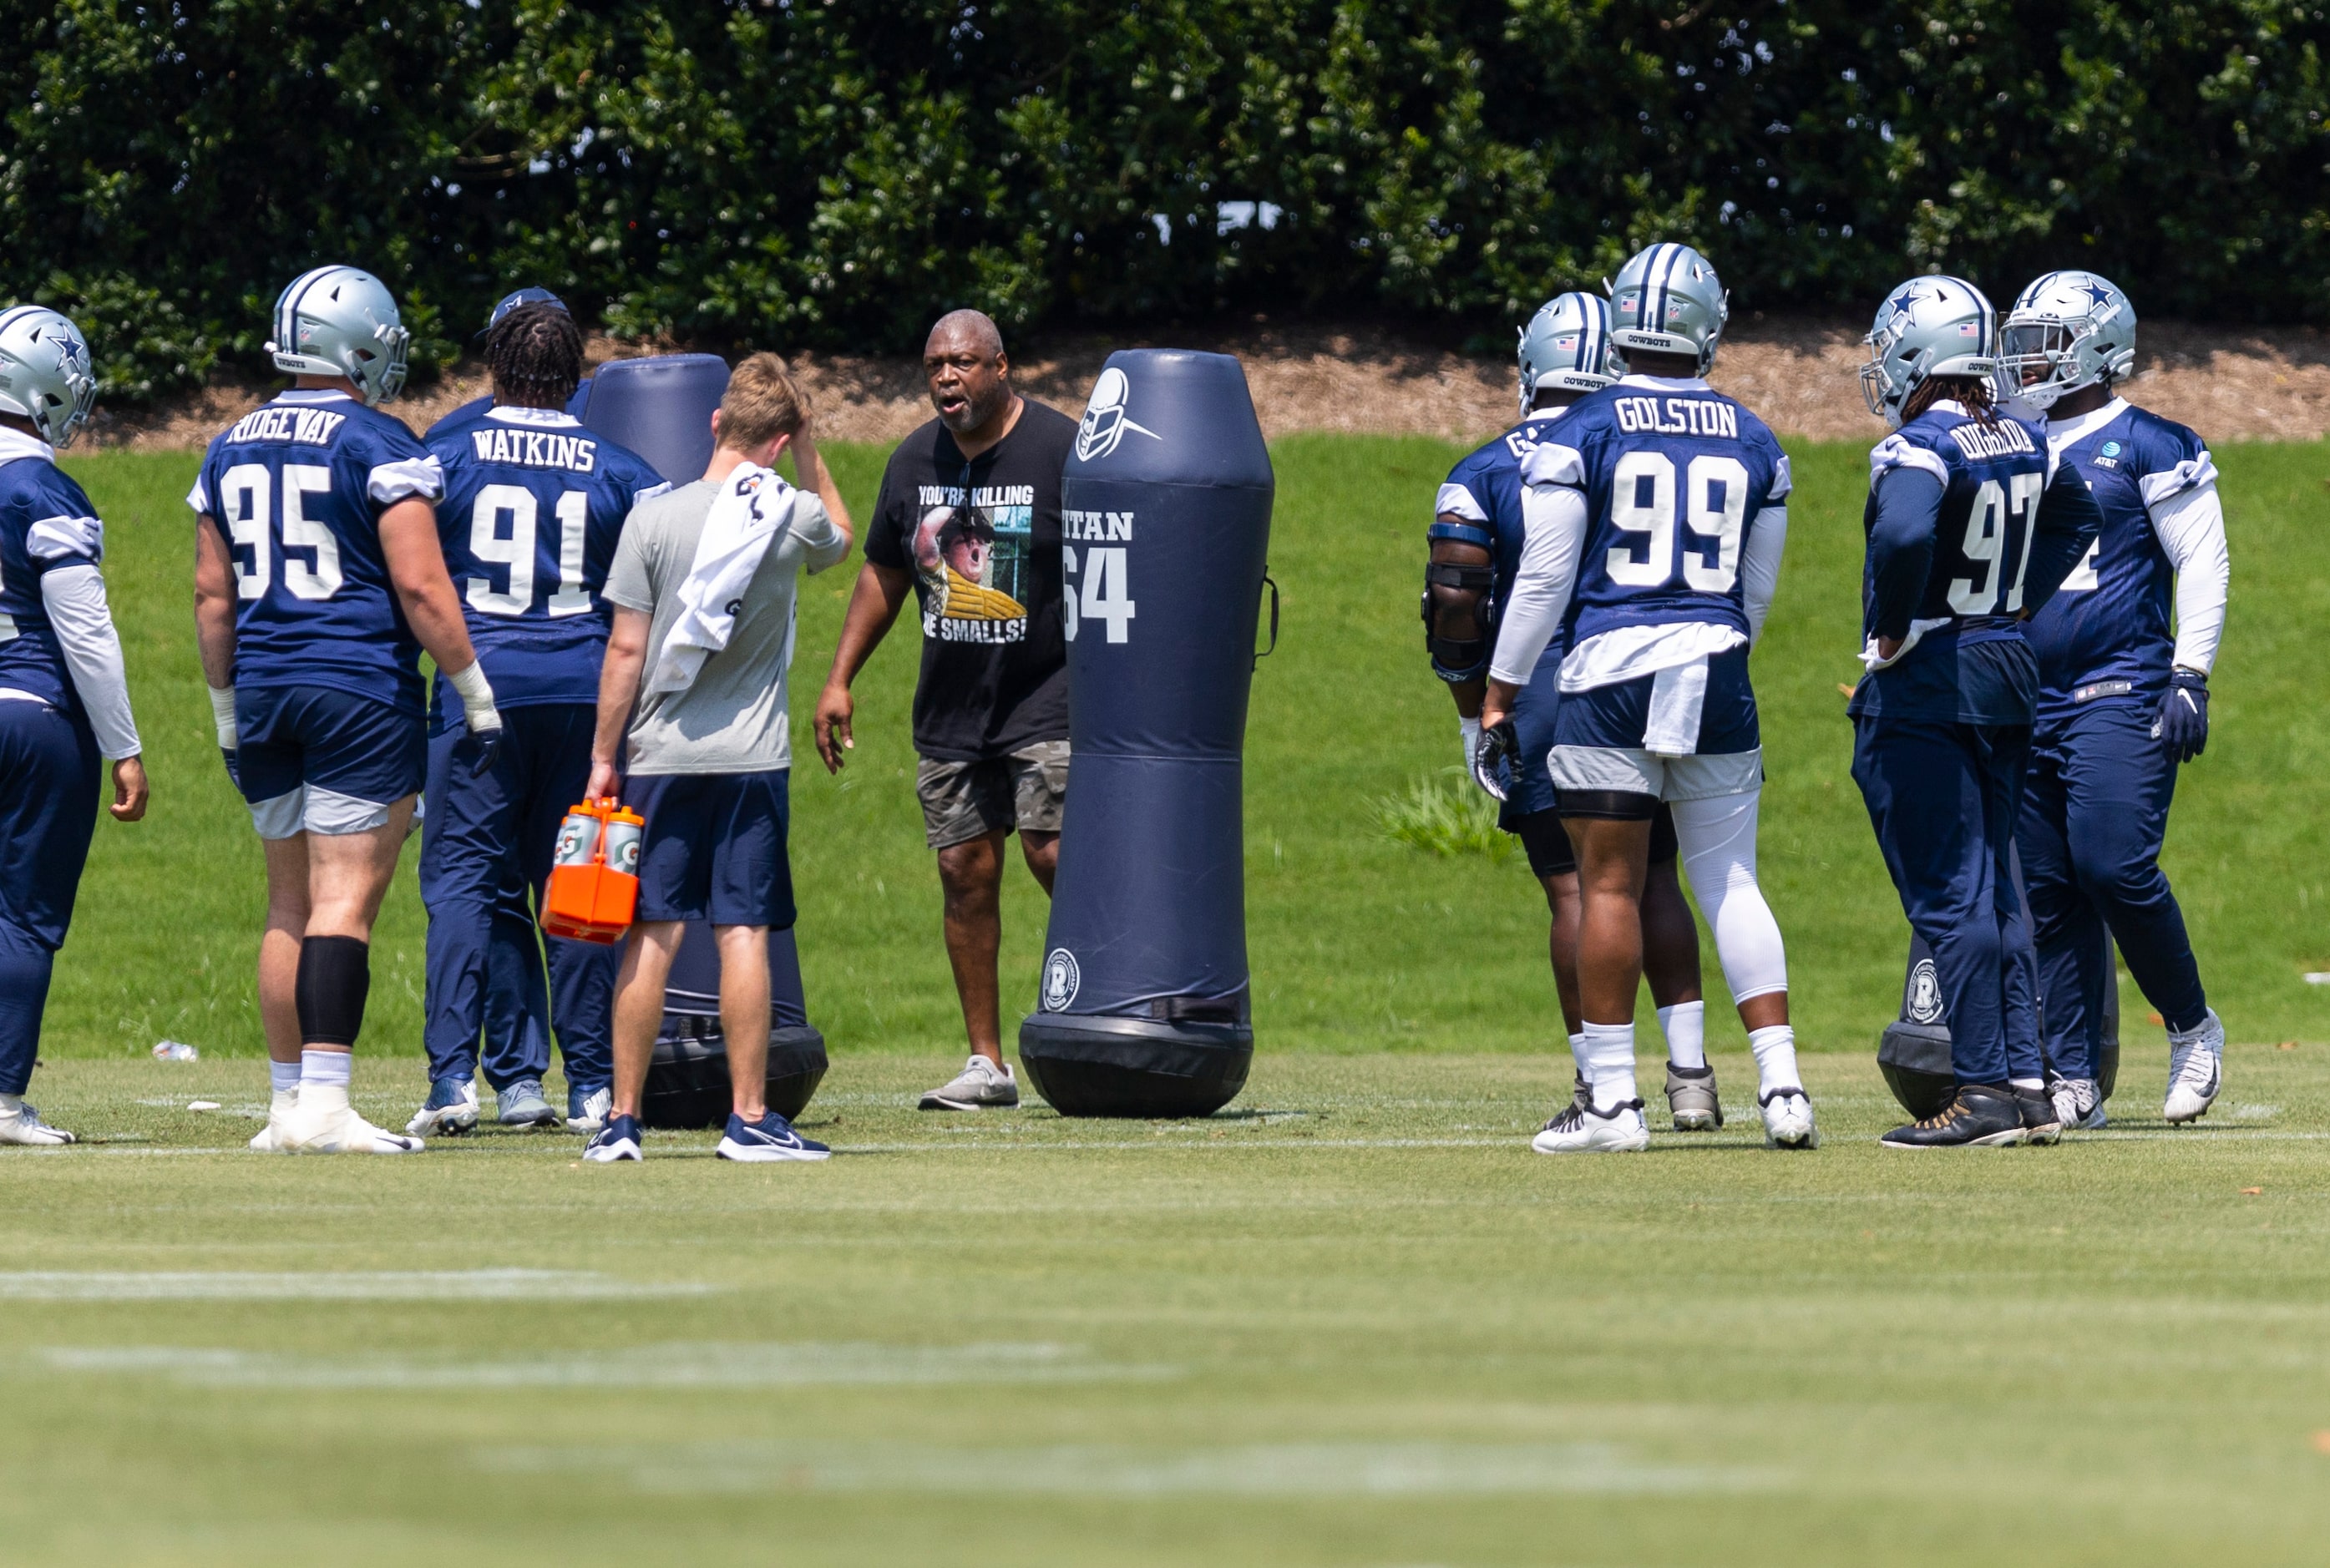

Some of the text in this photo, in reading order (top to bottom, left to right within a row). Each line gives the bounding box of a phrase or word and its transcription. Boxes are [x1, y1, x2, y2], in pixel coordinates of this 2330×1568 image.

[1628, 334, 1671, 347] COWBOYS
[1563, 377, 1606, 389] COWBOYS
[225, 407, 347, 445] RIDGEWAY
[1614, 397, 1737, 438] GOLSTON
[472, 429, 597, 472] WATKINS
[2094, 456, 2119, 468] AT&T
[971, 485, 1035, 507] KILLING
[220, 463, 343, 599] 95
[1061, 509, 1134, 541] ITAN
[1606, 451, 1749, 594] 99
[466, 483, 593, 617] 91
[1947, 472, 2043, 615] 97
[940, 618, 1027, 644] SMALLS!
[1049, 964, 1067, 997] R
[1914, 974, 1934, 1009] R
